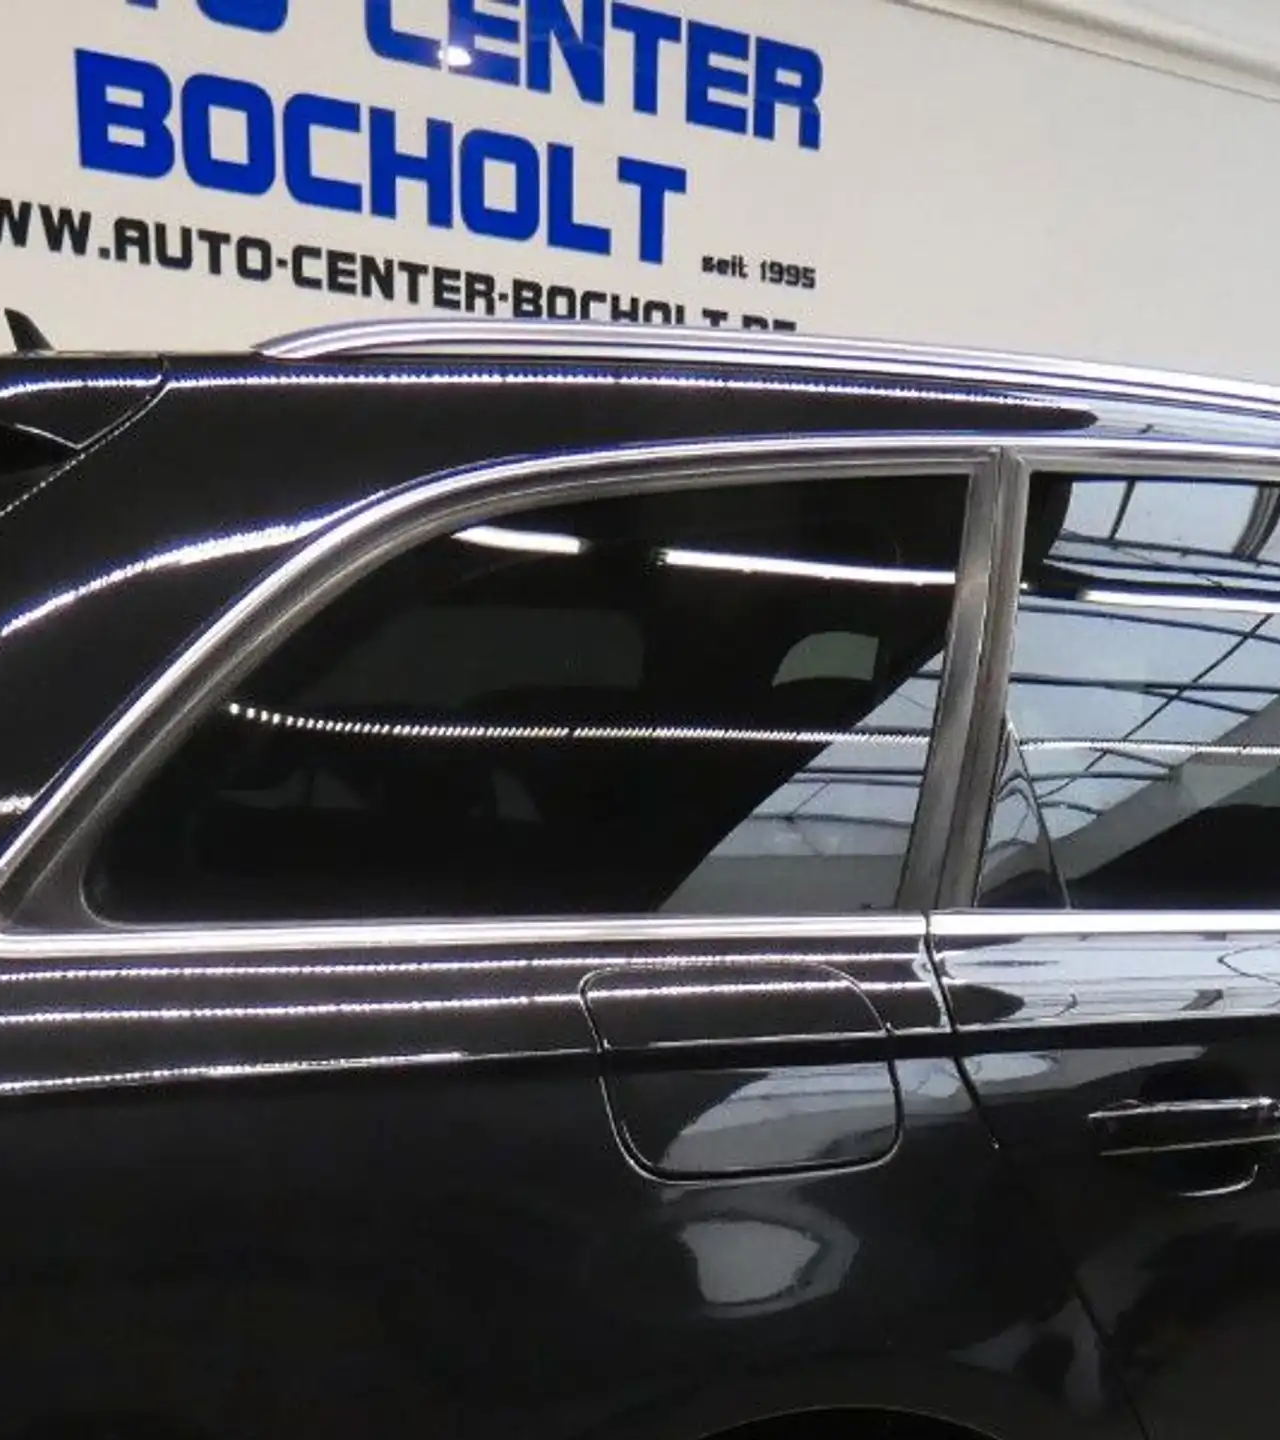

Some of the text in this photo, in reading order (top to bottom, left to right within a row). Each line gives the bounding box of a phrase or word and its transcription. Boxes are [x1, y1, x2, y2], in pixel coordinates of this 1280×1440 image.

[365, 0, 824, 151] CENTER
[74, 47, 687, 265] BOCHOLT
[701, 254, 816, 290] seit 1995
